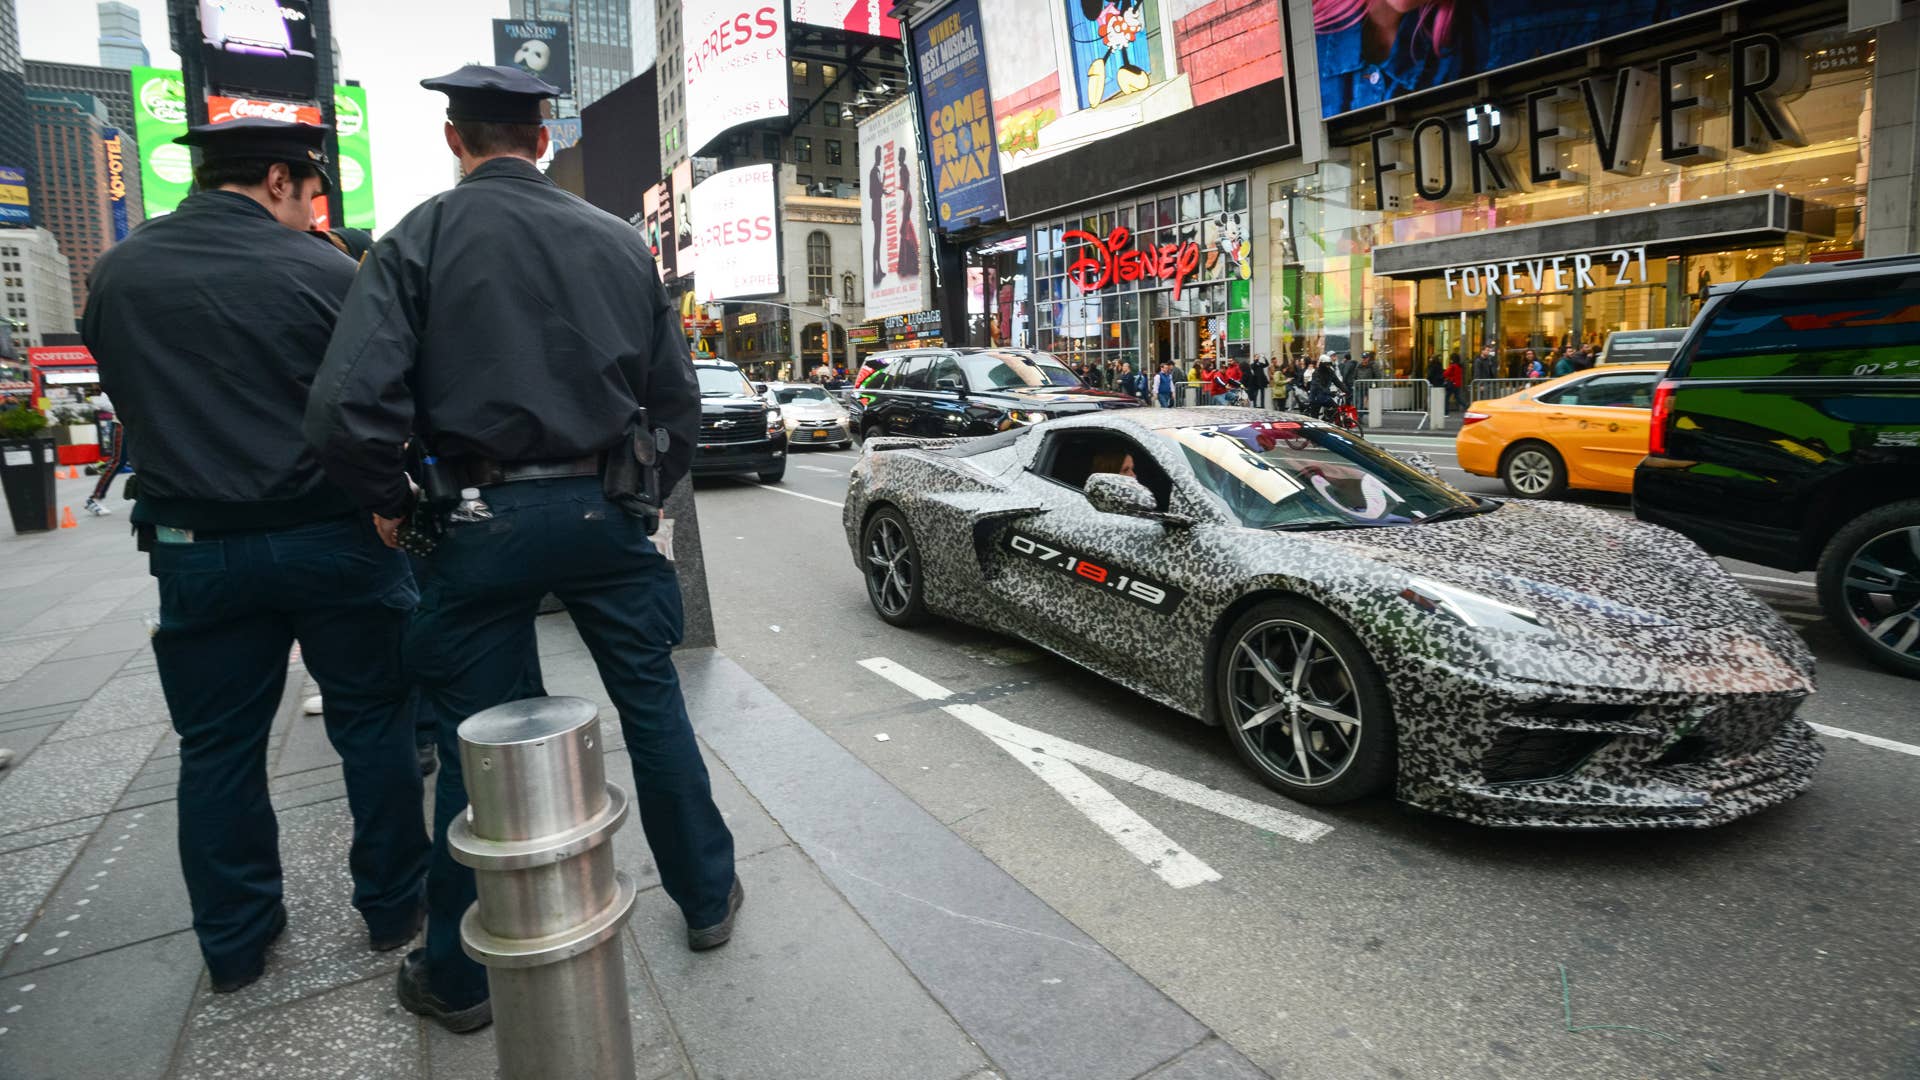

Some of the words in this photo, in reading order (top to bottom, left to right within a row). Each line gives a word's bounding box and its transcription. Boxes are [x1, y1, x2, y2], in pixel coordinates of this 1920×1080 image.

[504, 23, 557, 36] PHANTOM
[687, 6, 778, 85] EXPRESS
[920, 46, 939, 75] BEST
[940, 24, 977, 63] MUSICAL
[928, 11, 961, 47] WINNER!
[930, 88, 987, 137] COME
[1370, 33, 1800, 211] FOREVER
[932, 117, 991, 166] FROM
[103, 135, 126, 201] NOVOTEL
[884, 140, 896, 198] PRETTY
[938, 146, 992, 193] AWAY
[886, 209, 898, 273] WOMAN
[1445, 253, 1595, 299] FOREVER
[1612, 247, 1649, 287] 21
[885, 315, 904, 329] GIFTS
[907, 309, 941, 325] LUGGAGE
[1010, 535, 1166, 605] 07.18.19
